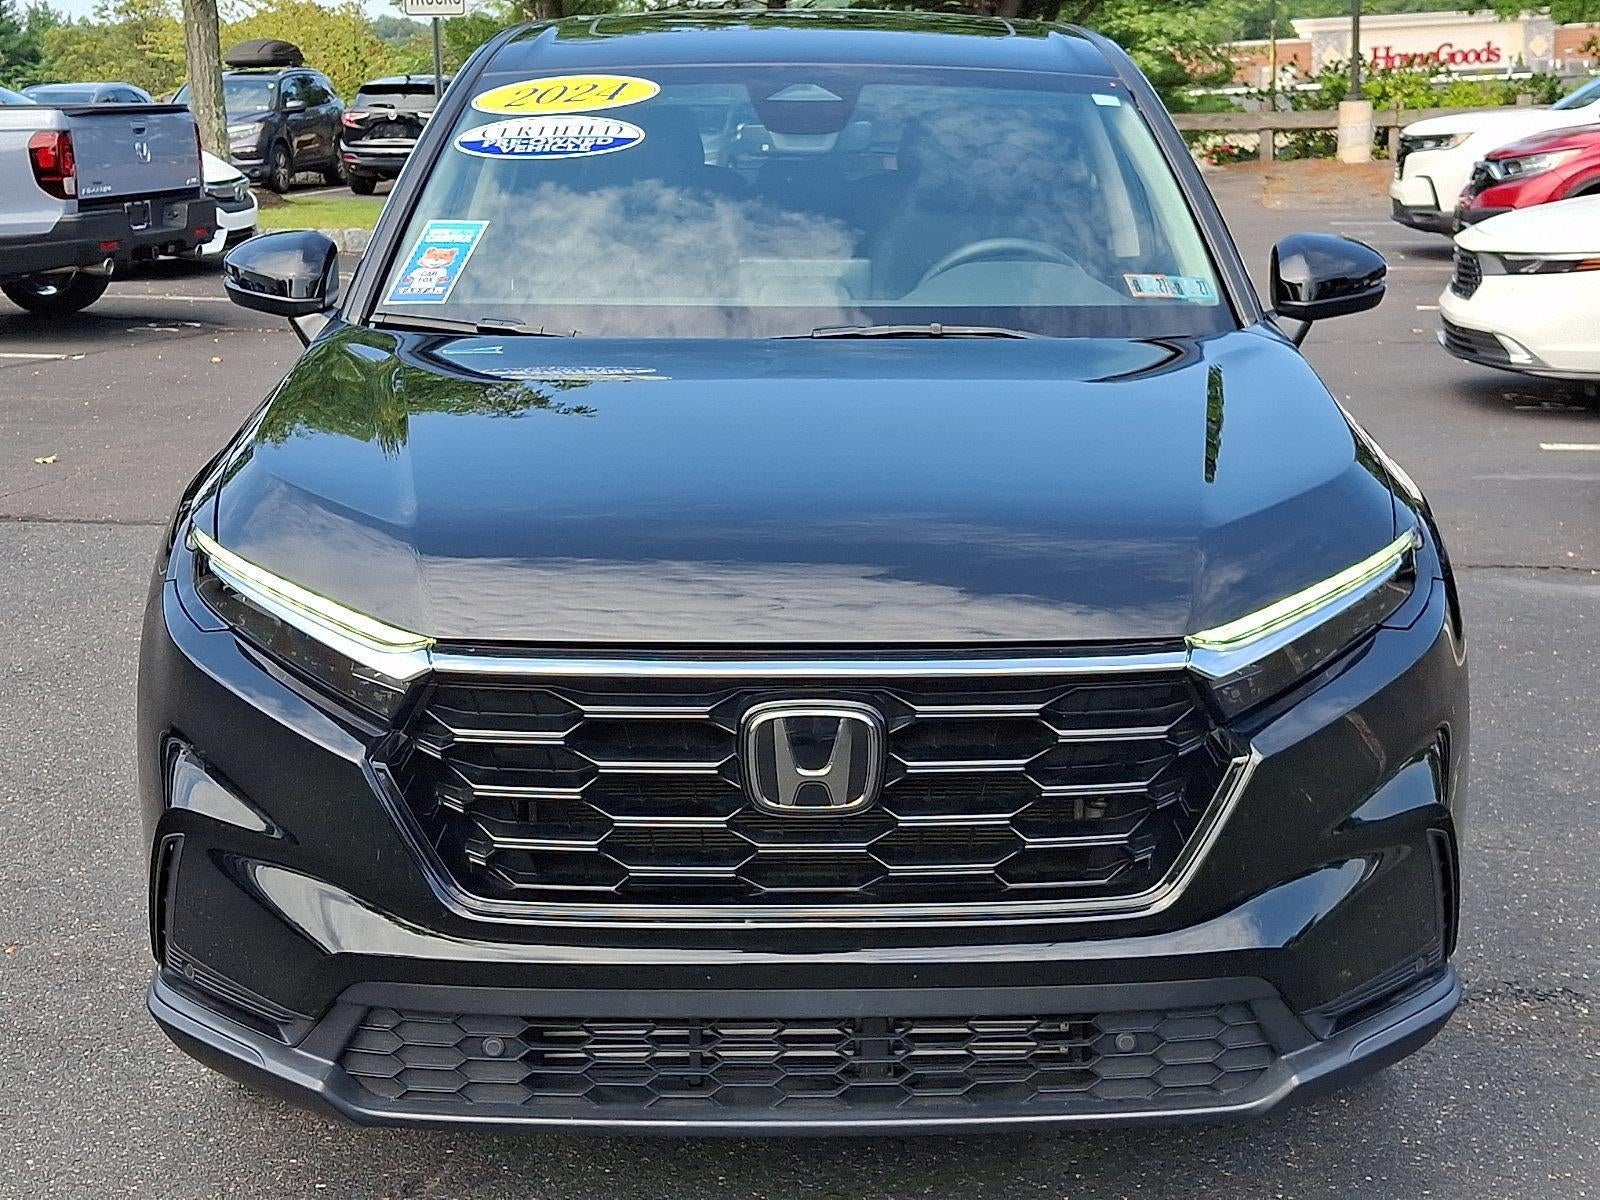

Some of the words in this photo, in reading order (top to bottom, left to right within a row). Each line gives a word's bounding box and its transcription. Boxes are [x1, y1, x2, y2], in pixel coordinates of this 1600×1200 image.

[504, 82, 629, 108] 2024
[1132, 279, 1142, 293] 8
[1174, 282, 1184, 295] 8
